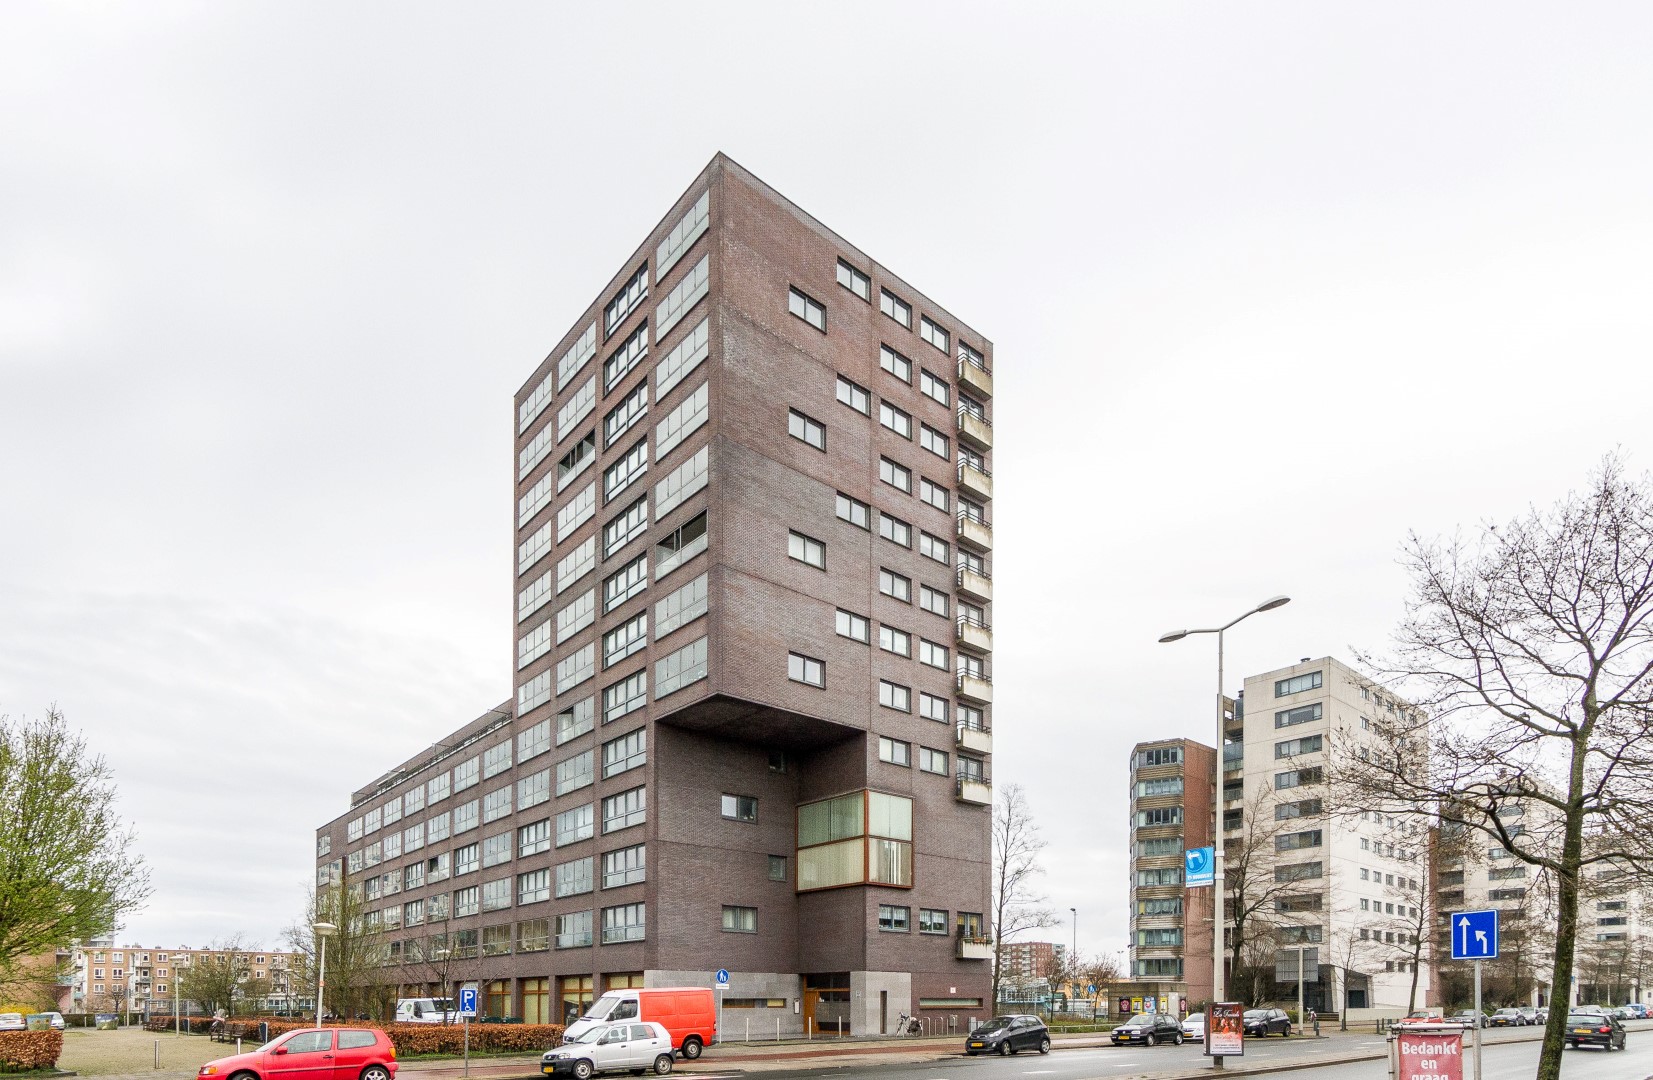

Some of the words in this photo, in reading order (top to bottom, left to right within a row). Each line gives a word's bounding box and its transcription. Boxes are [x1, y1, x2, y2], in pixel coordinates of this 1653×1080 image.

[464, 991, 473, 1003] P
[1401, 1042, 1457, 1055] Bedankt
[1421, 1060, 1437, 1069] en
